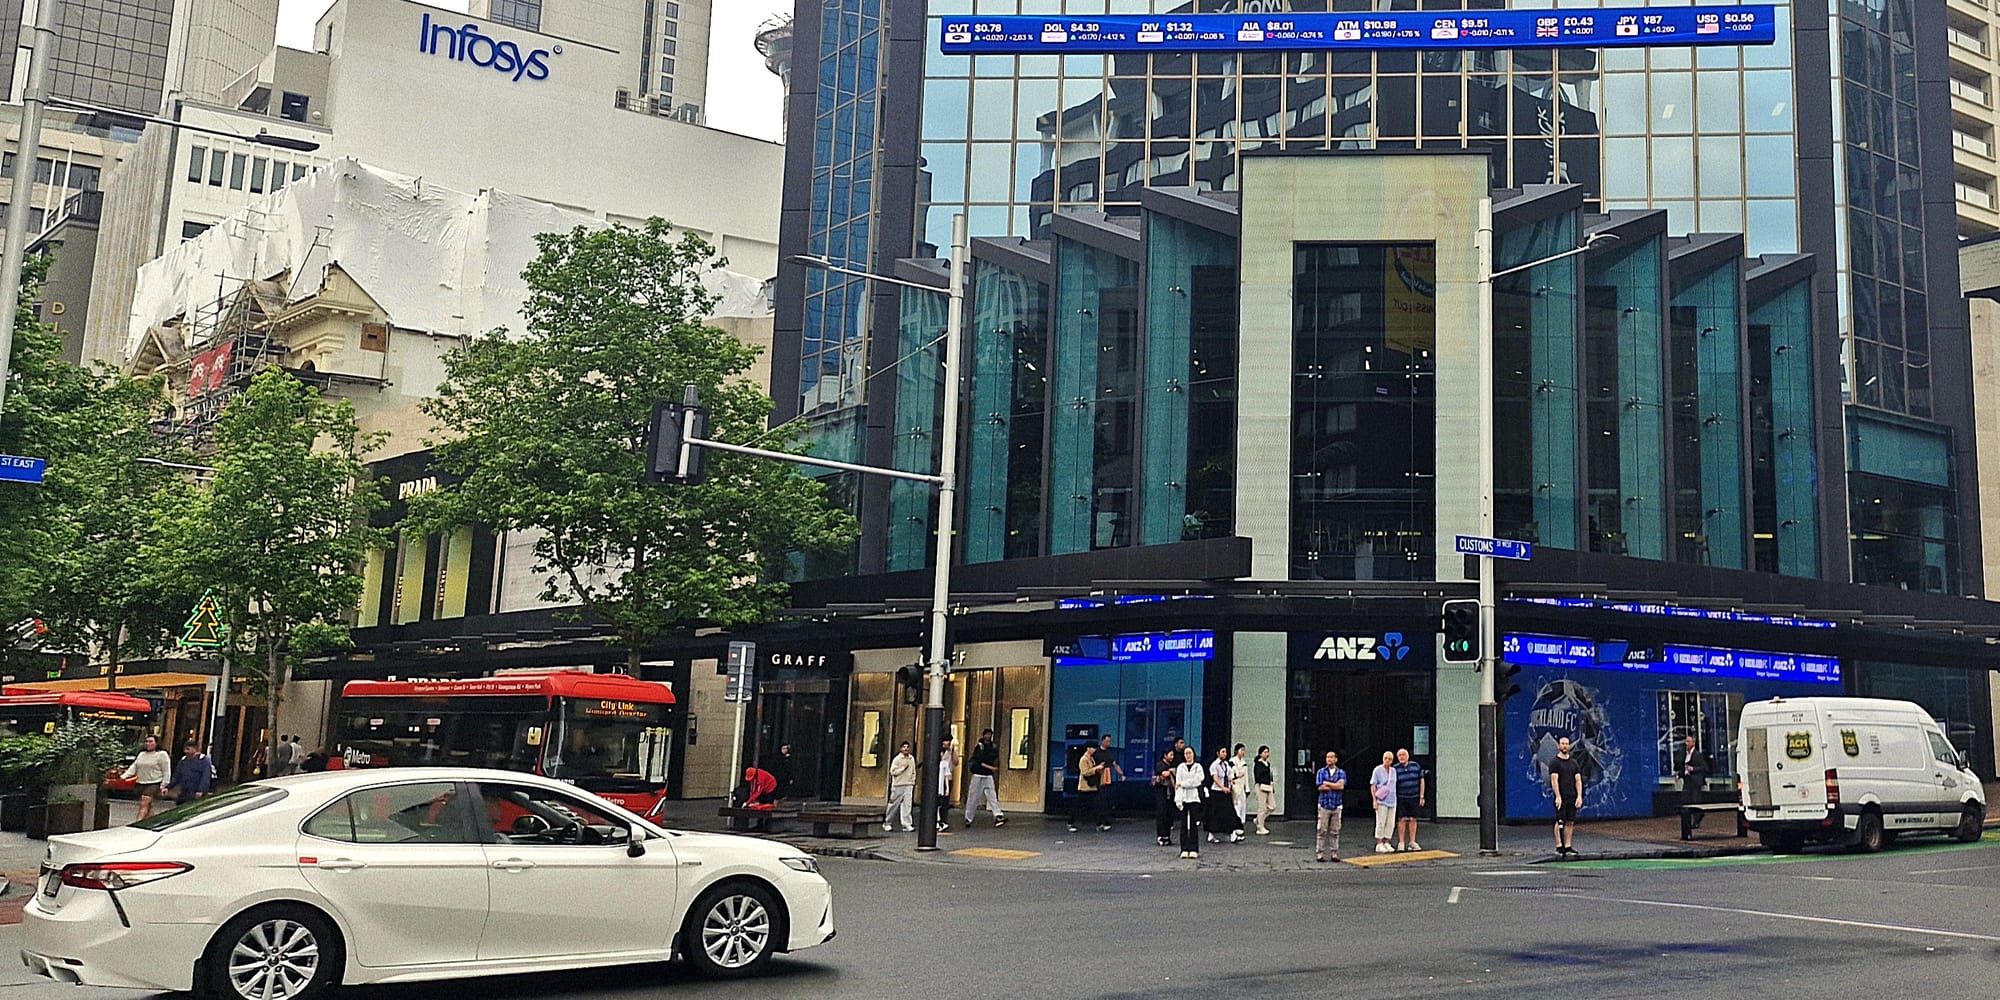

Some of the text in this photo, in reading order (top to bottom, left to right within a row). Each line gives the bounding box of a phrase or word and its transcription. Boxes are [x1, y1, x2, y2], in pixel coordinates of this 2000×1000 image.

[1537, 17, 1594, 26] GBP £0.43
[1617, 15, 1663, 25] JPY ¥87
[1696, 13, 1755, 23] USD $0.56
[947, 24, 1002, 32] CVT $0.78
[1044, 23, 1100, 32] DGL $4.30
[1141, 23, 1193, 32] DIV $1.32
[1242, 22, 1294, 31] AIA $8.01
[1336, 20, 1397, 30] ATM $10.98
[1434, 19, 1488, 28] CEN $9.51
[420, 13, 549, 82] Infosys
[1, 457, 35, 469] ST EAST
[398, 476, 437, 500] PRADA
[1459, 538, 1494, 553] CUSTOMS
[1053, 646, 1071, 655] ANZ
[1124, 641, 1142, 652] ANZ
[1313, 636, 1376, 660] ANZ
[1628, 650, 1646, 660] ANZ
[771, 654, 827, 667] GRAFF
[601, 701, 634, 711] City Link
[1565, 711, 1577, 732] FC
[1789, 738, 1809, 748] ACM
[351, 748, 371, 765] Metro
